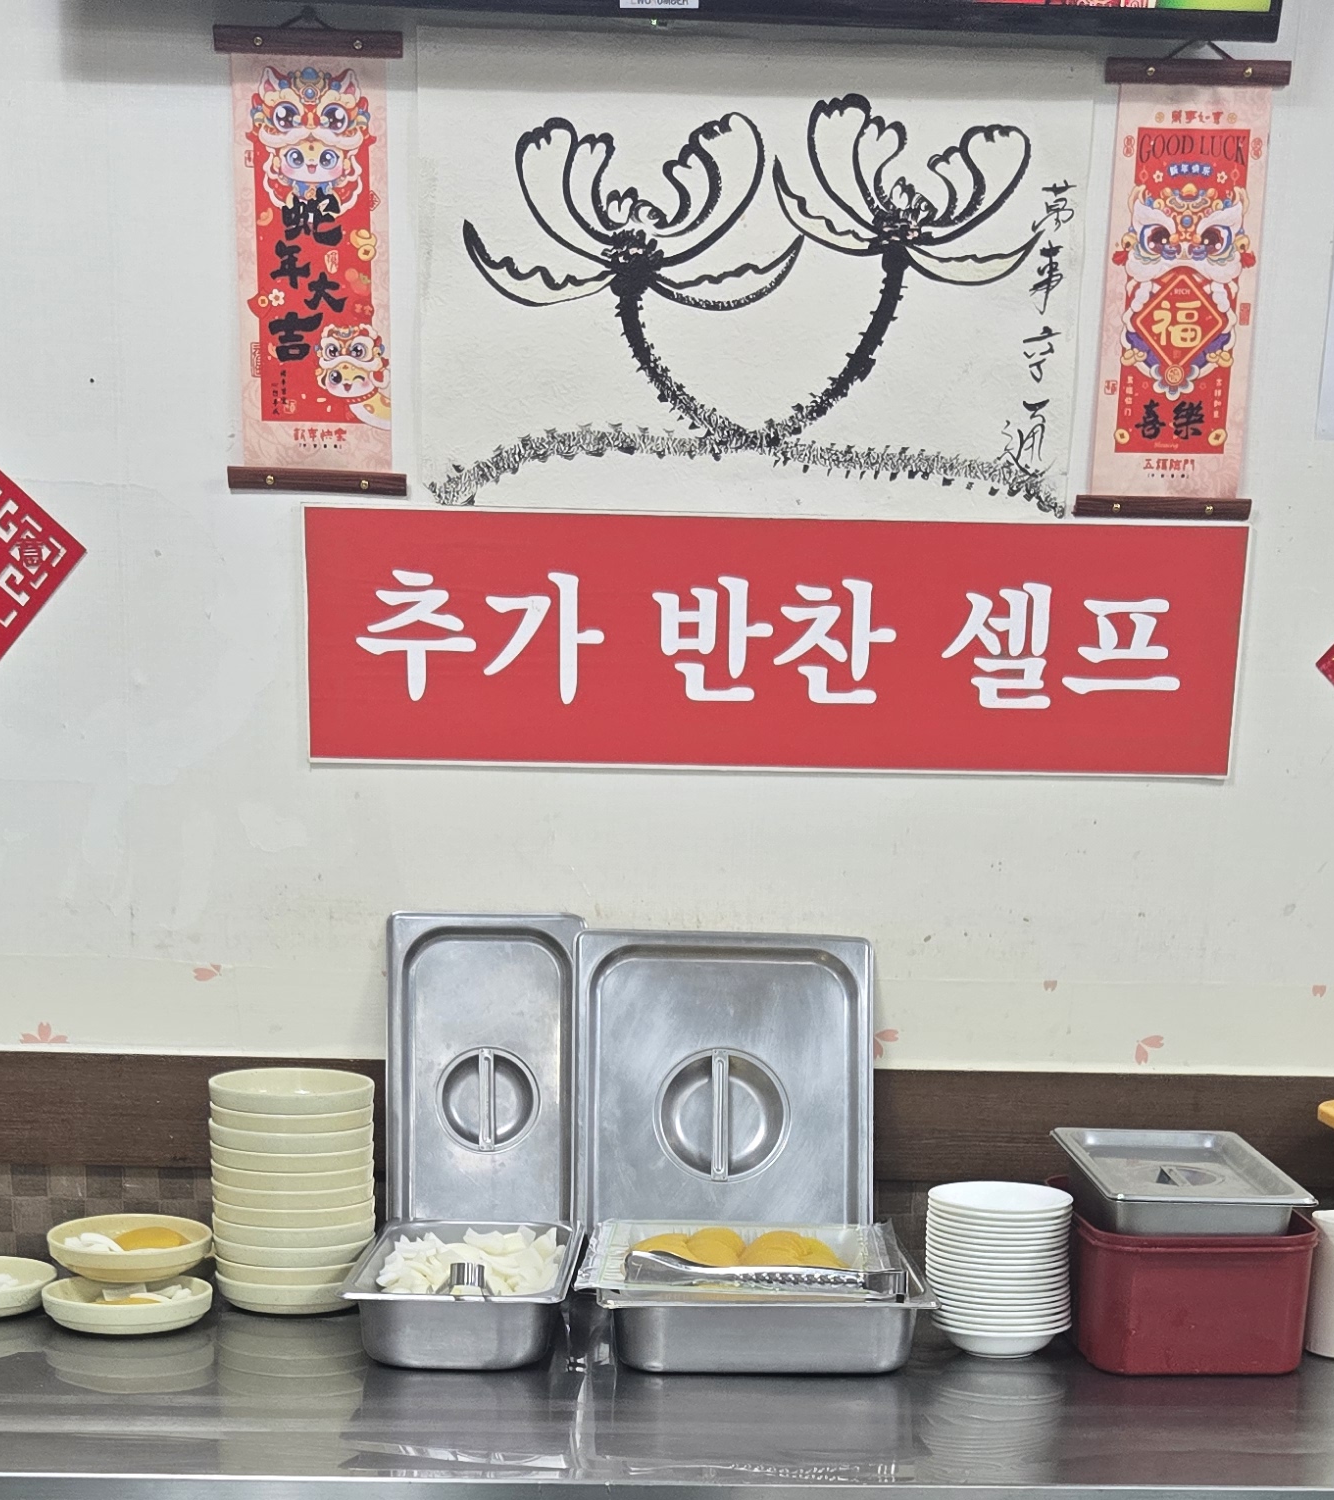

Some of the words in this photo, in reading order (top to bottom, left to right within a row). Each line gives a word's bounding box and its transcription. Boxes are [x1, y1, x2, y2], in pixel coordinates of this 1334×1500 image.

[1138, 133, 1196, 164] GOOD
[1200, 134, 1247, 167] LUCK
[268, 186, 348, 362] 蛇年大吉
[1151, 300, 1202, 348] 福
[1135, 399, 1206, 441] 喜樂
[355, 568, 605, 705] 추가
[652, 575, 897, 707] 반찬
[941, 581, 1181, 711] 셀프
